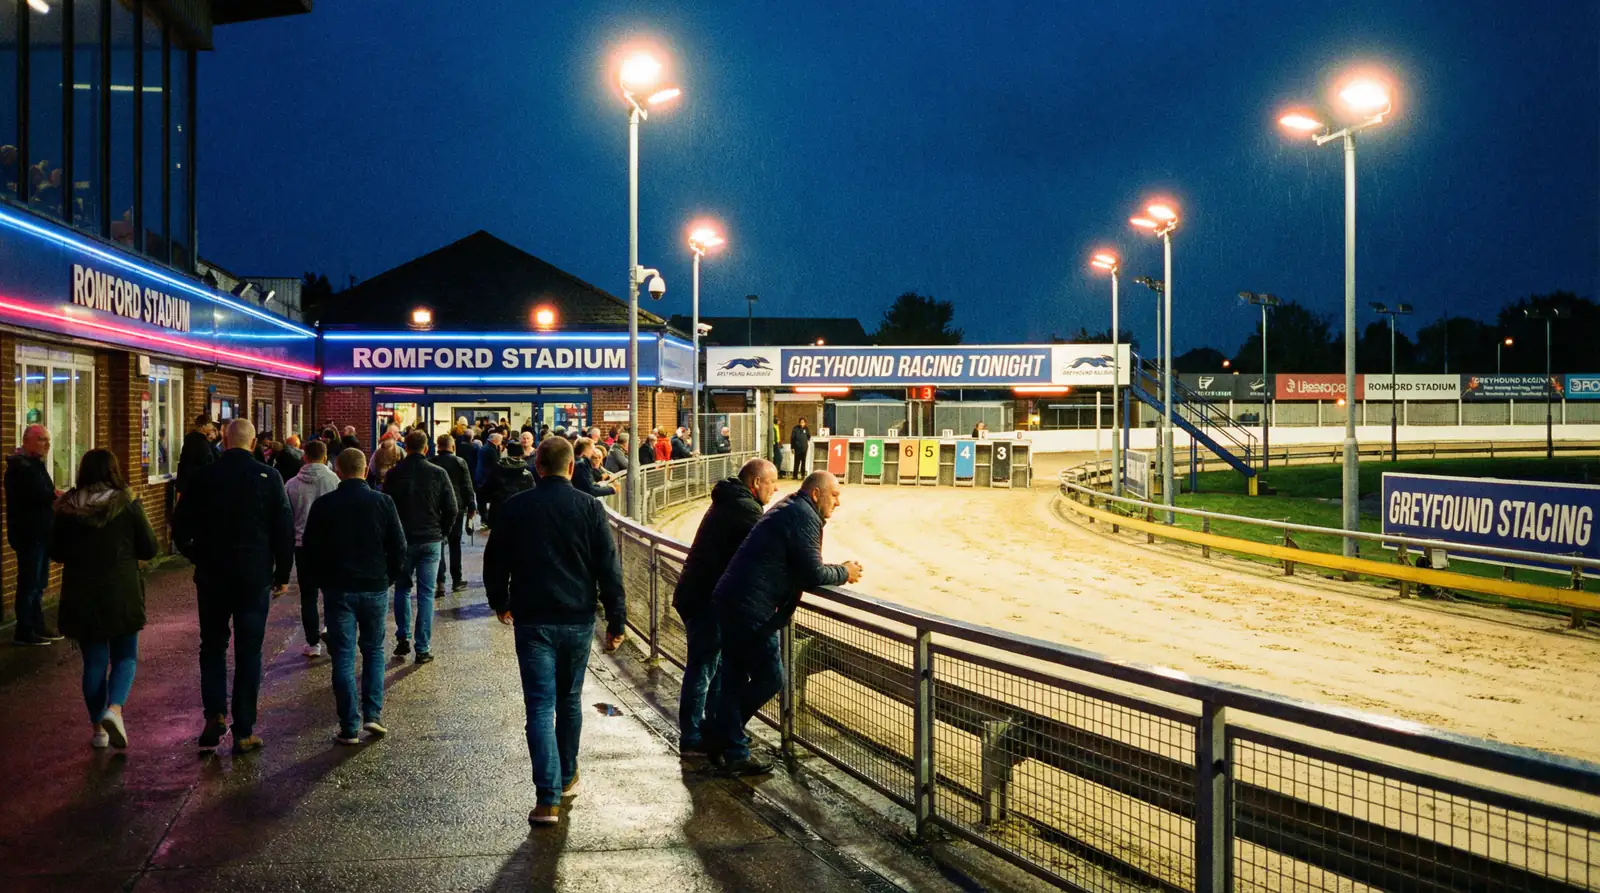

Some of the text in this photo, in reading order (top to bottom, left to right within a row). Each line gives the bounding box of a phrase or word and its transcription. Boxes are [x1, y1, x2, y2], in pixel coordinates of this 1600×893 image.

[73, 264, 190, 332] ROMFORD STADIUM
[353, 348, 626, 369] ROMFORD STADIUM
[788, 354, 1045, 377] GREYHOUND RACING TONIGHT
[1368, 383, 1456, 391] ROMFORD STADIUM
[834, 444, 842, 457] 1
[868, 444, 879, 457] 8
[904, 445, 914, 457] 6
[924, 446, 934, 458] 5
[960, 445, 971, 459] 4
[996, 446, 1007, 460] 3
[1389, 491, 1593, 547] GREYFOUND STACING
